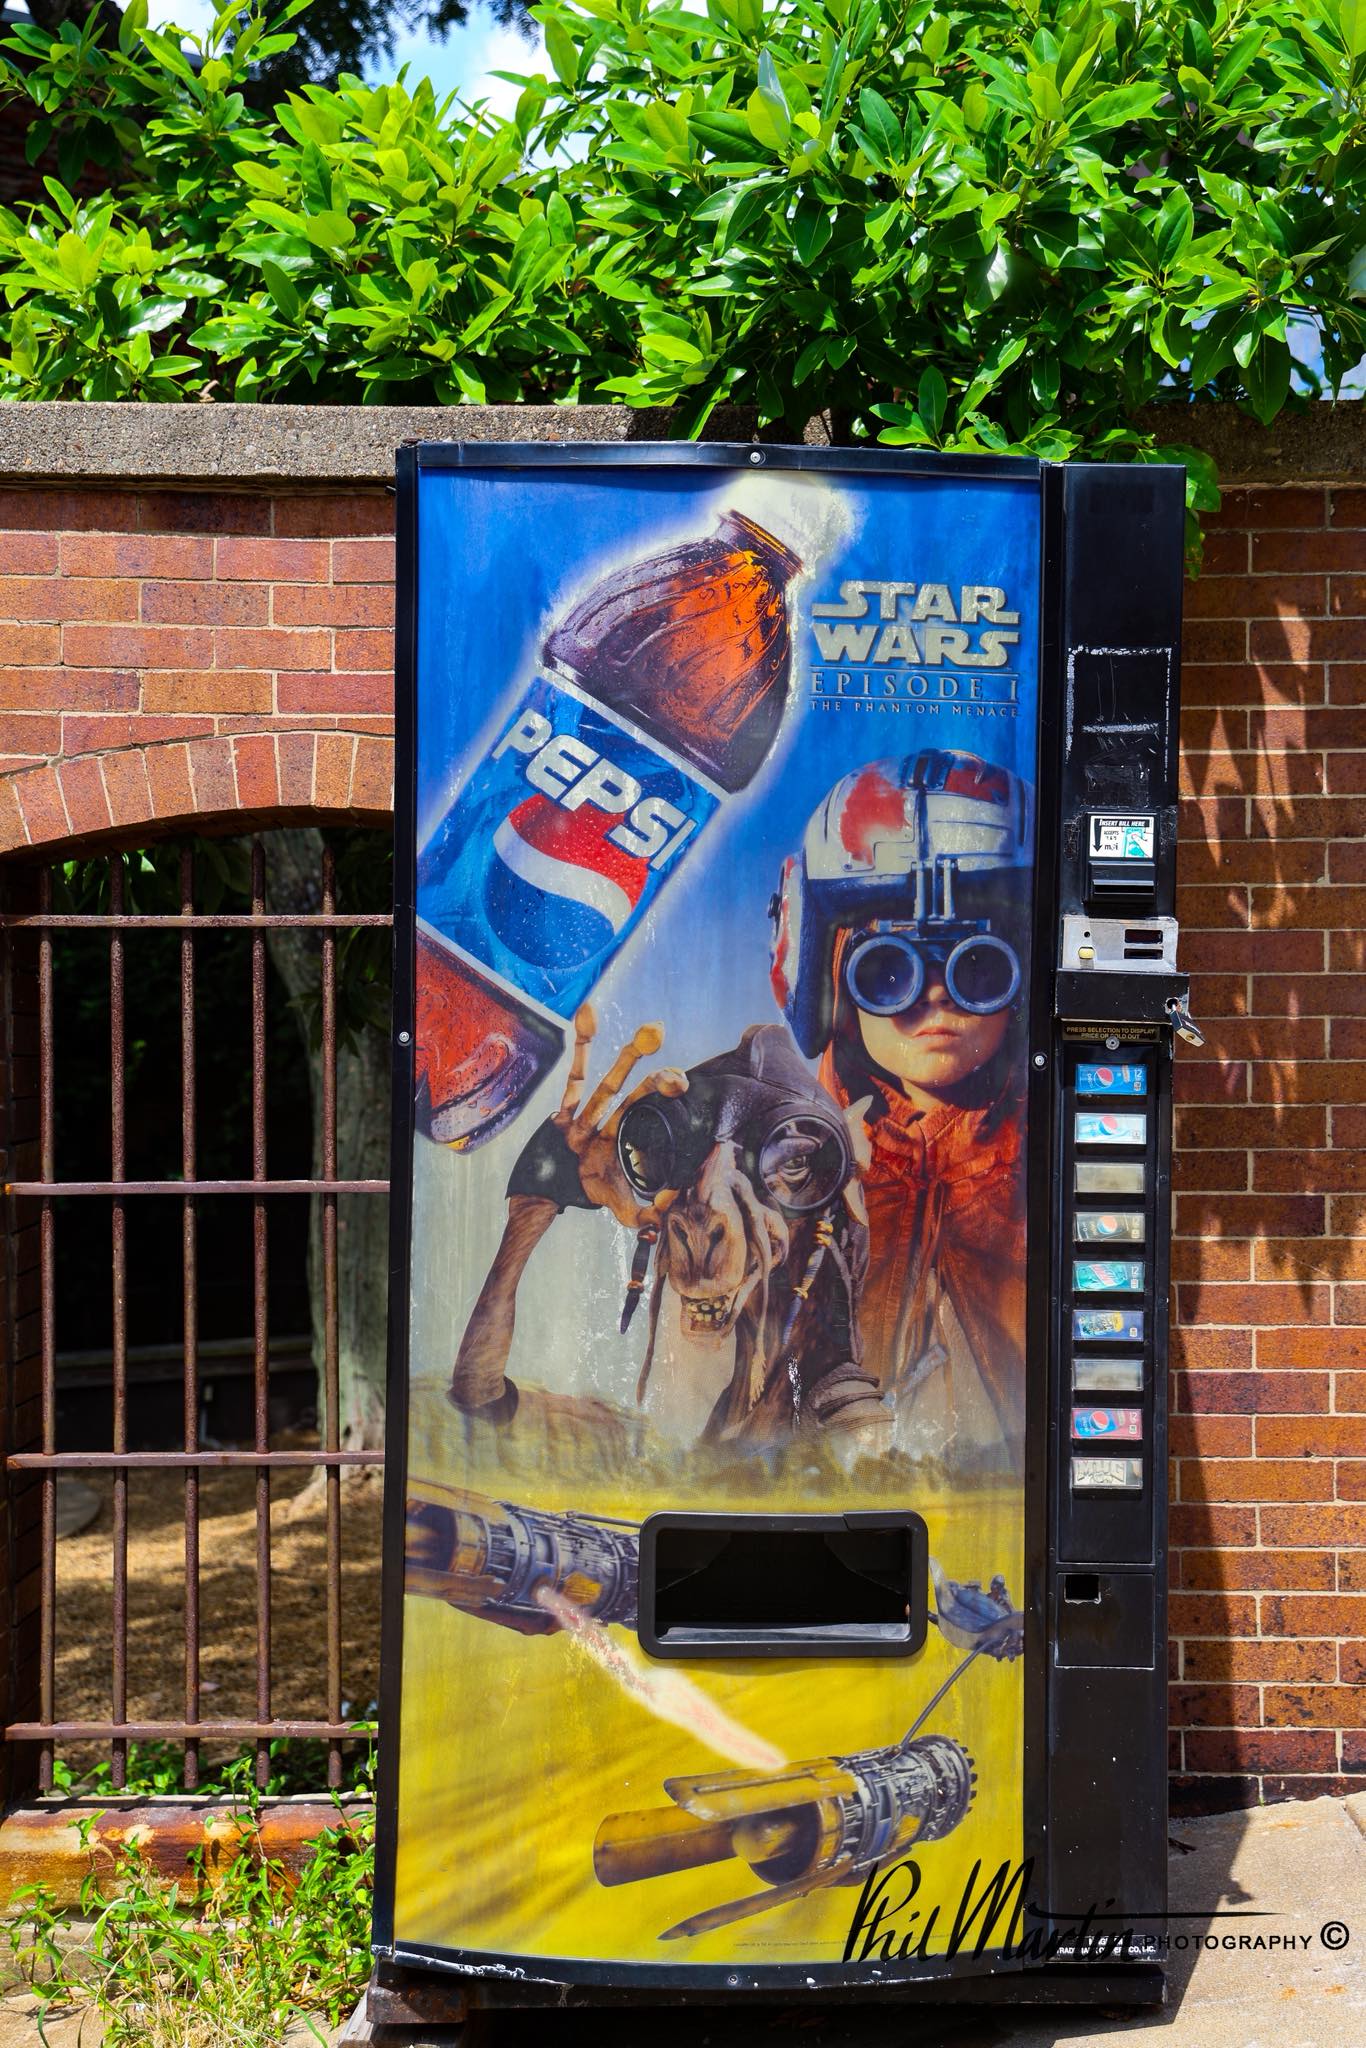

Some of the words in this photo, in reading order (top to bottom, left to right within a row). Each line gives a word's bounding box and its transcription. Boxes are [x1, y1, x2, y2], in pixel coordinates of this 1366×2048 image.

[811, 581, 1020, 624] STAR
[812, 623, 1020, 667] WARS
[810, 672, 984, 699] EPISODE
[1009, 679, 1020, 702] I
[810, 701, 841, 711] THE
[855, 703, 940, 715] PHANTOM
[952, 706, 1018, 718] MENACE
[491, 708, 697, 870] PEPSI
[1131, 1266, 1139, 1275] 12
